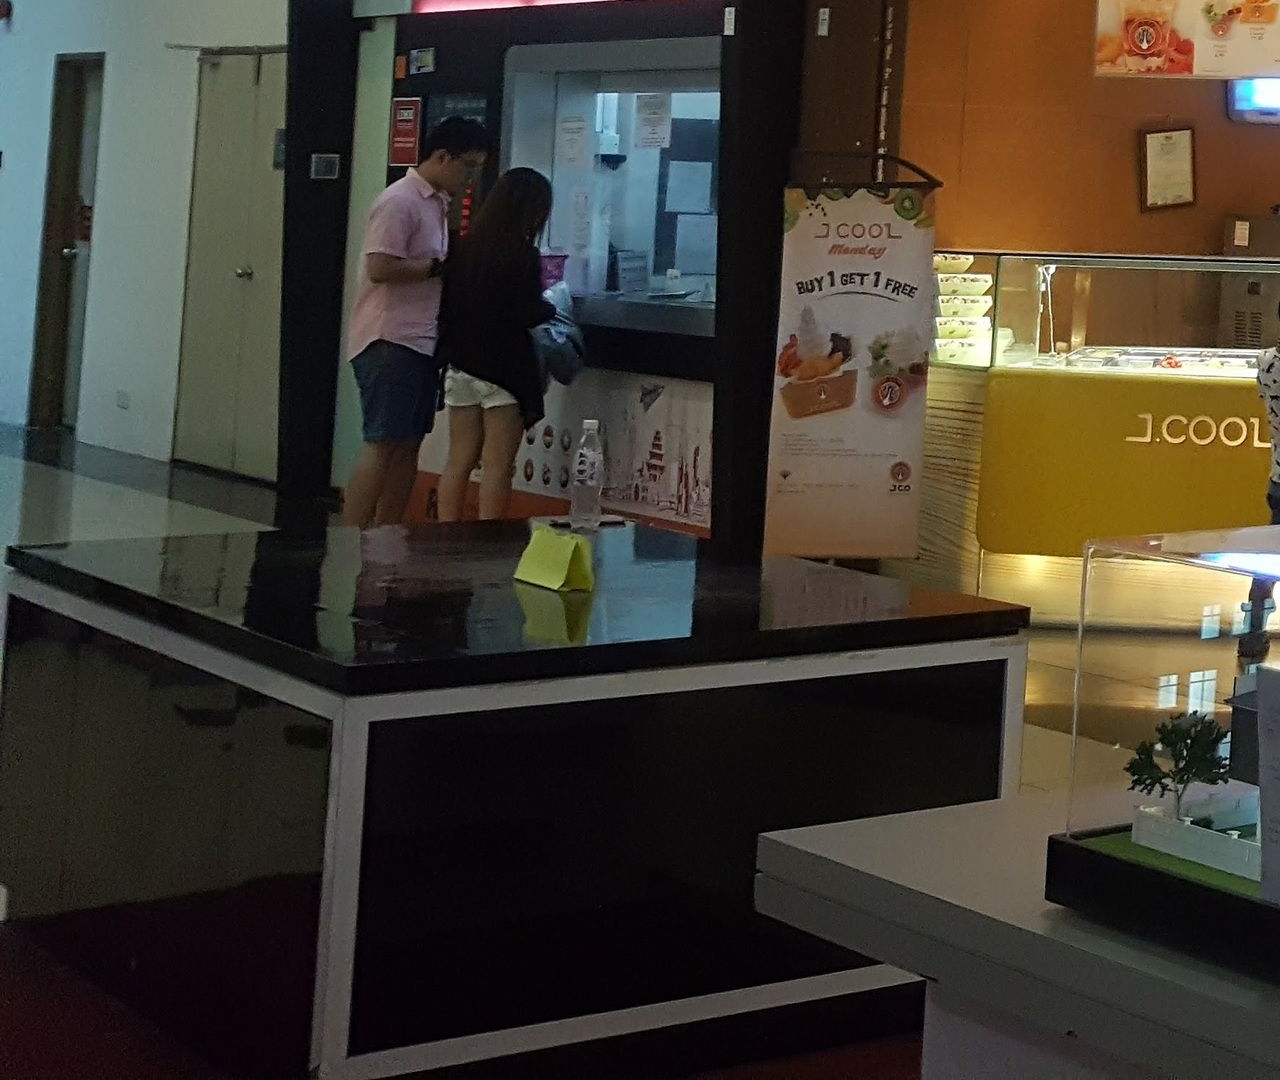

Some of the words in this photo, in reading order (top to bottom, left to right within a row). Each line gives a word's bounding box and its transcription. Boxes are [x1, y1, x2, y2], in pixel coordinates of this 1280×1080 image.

[827, 243, 888, 260] Monday
[795, 276, 824, 295] BUY
[827, 270, 836, 288] 1
[840, 272, 870, 286] GET
[873, 271, 882, 288] 1
[884, 277, 919, 299] FREE
